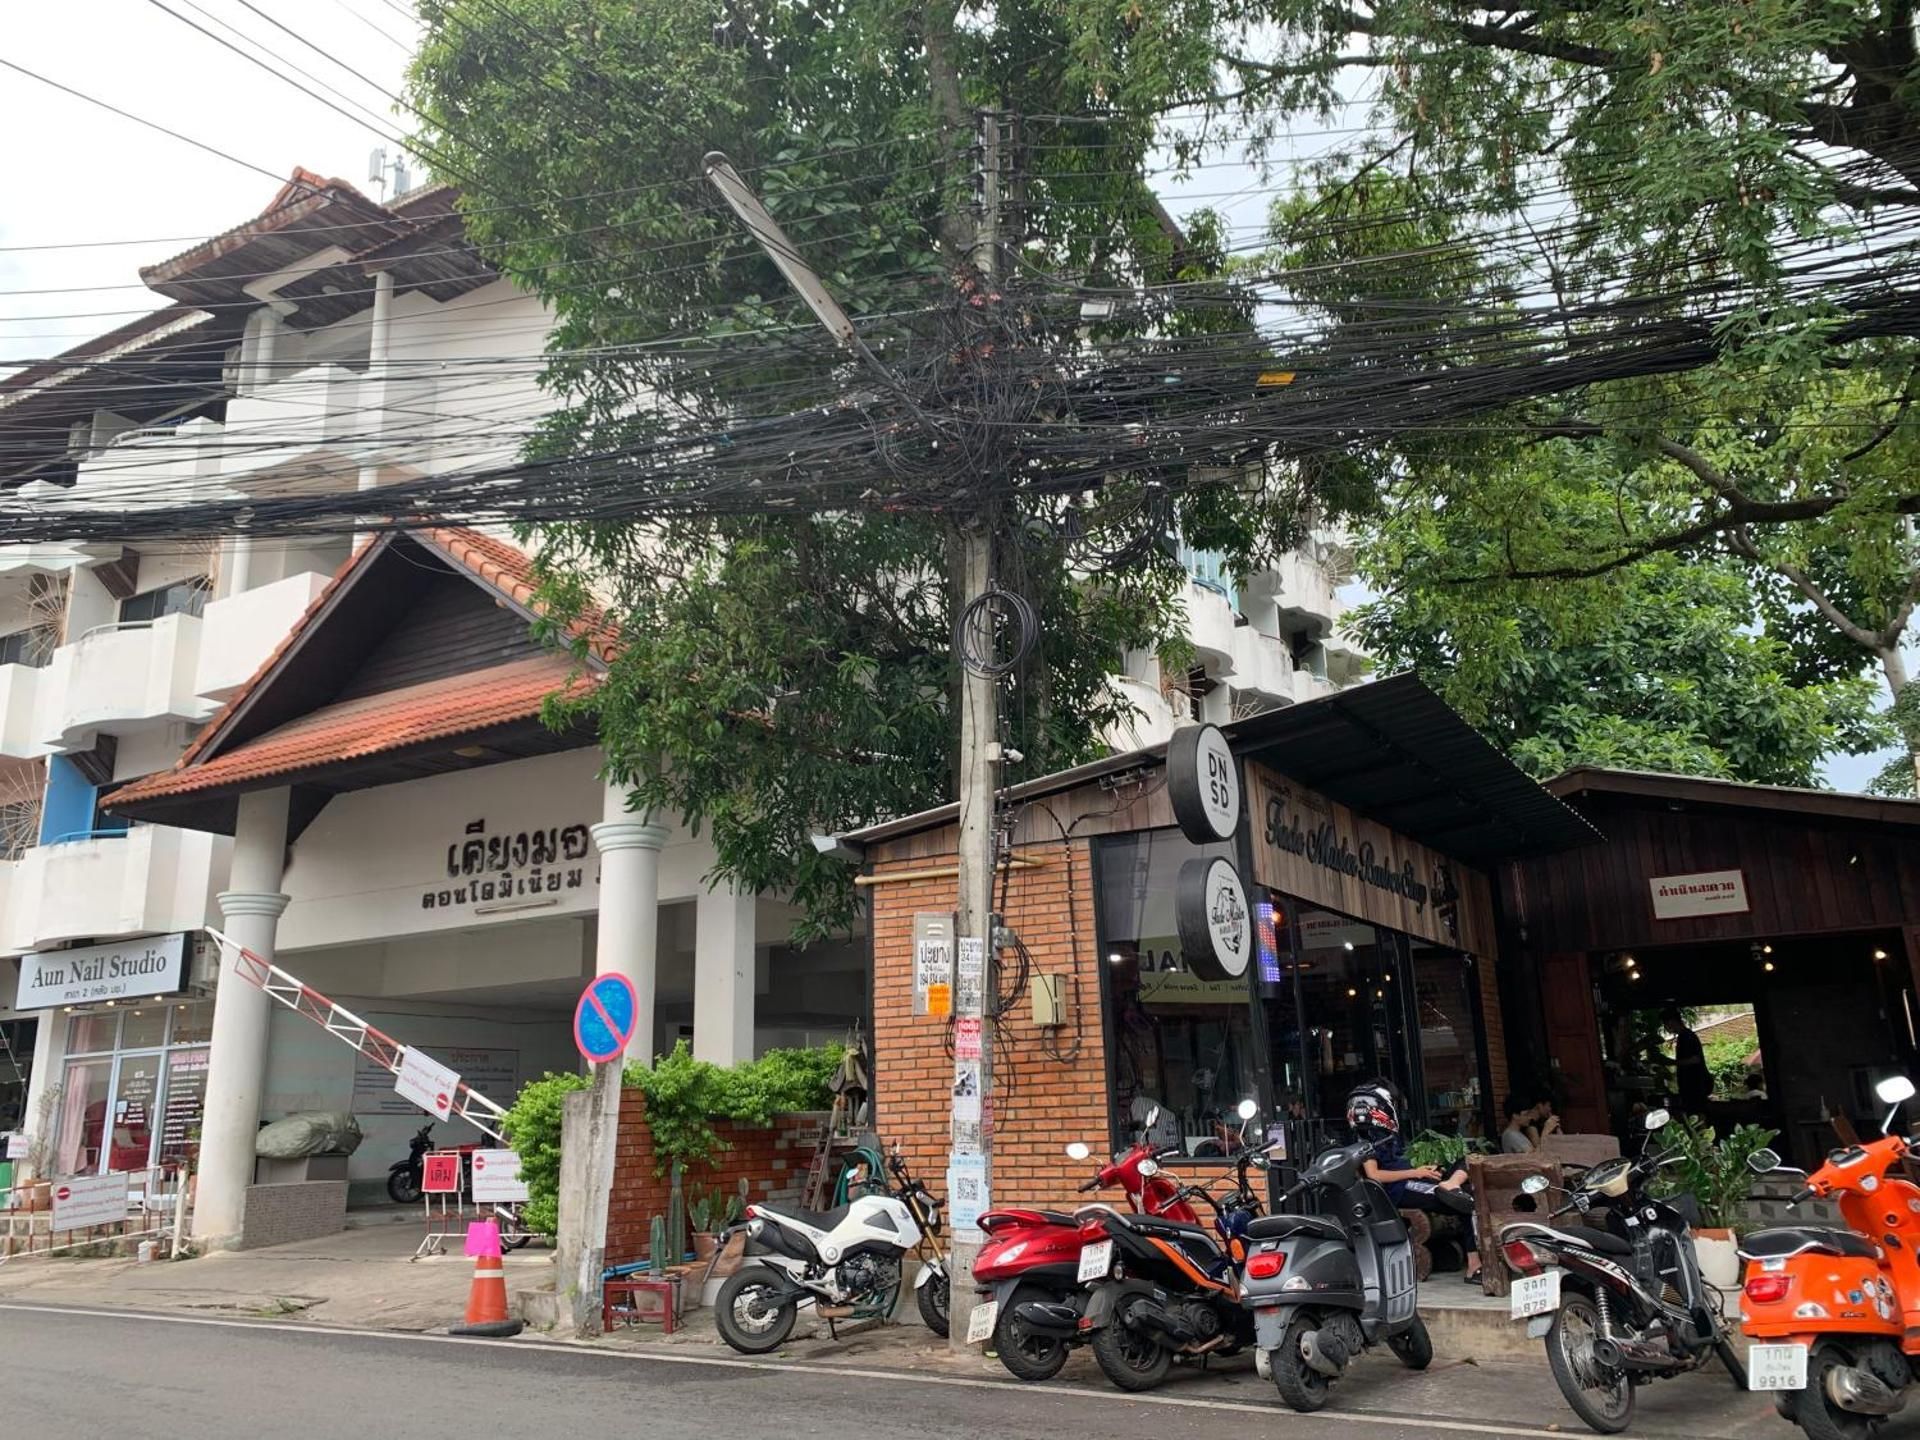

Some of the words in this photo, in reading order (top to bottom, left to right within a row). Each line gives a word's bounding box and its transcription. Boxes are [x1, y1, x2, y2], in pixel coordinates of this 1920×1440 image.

[1208, 752, 1228, 783] DN
[1210, 780, 1229, 809] SD
[447, 818, 589, 878] เคียงมอ
[1264, 796, 1305, 857] Fade
[1306, 821, 1359, 878] Master
[1358, 841, 1403, 895] Barber
[920, 942, 950, 964] ปะยาง
[31, 966, 64, 988] Aun
[69, 959, 105, 984] Nail
[109, 950, 167, 979] Studio
[82, 988, 88, 998] 2
[1523, 1299, 1547, 1313] 879
[1759, 1375, 1797, 1388] 9916
